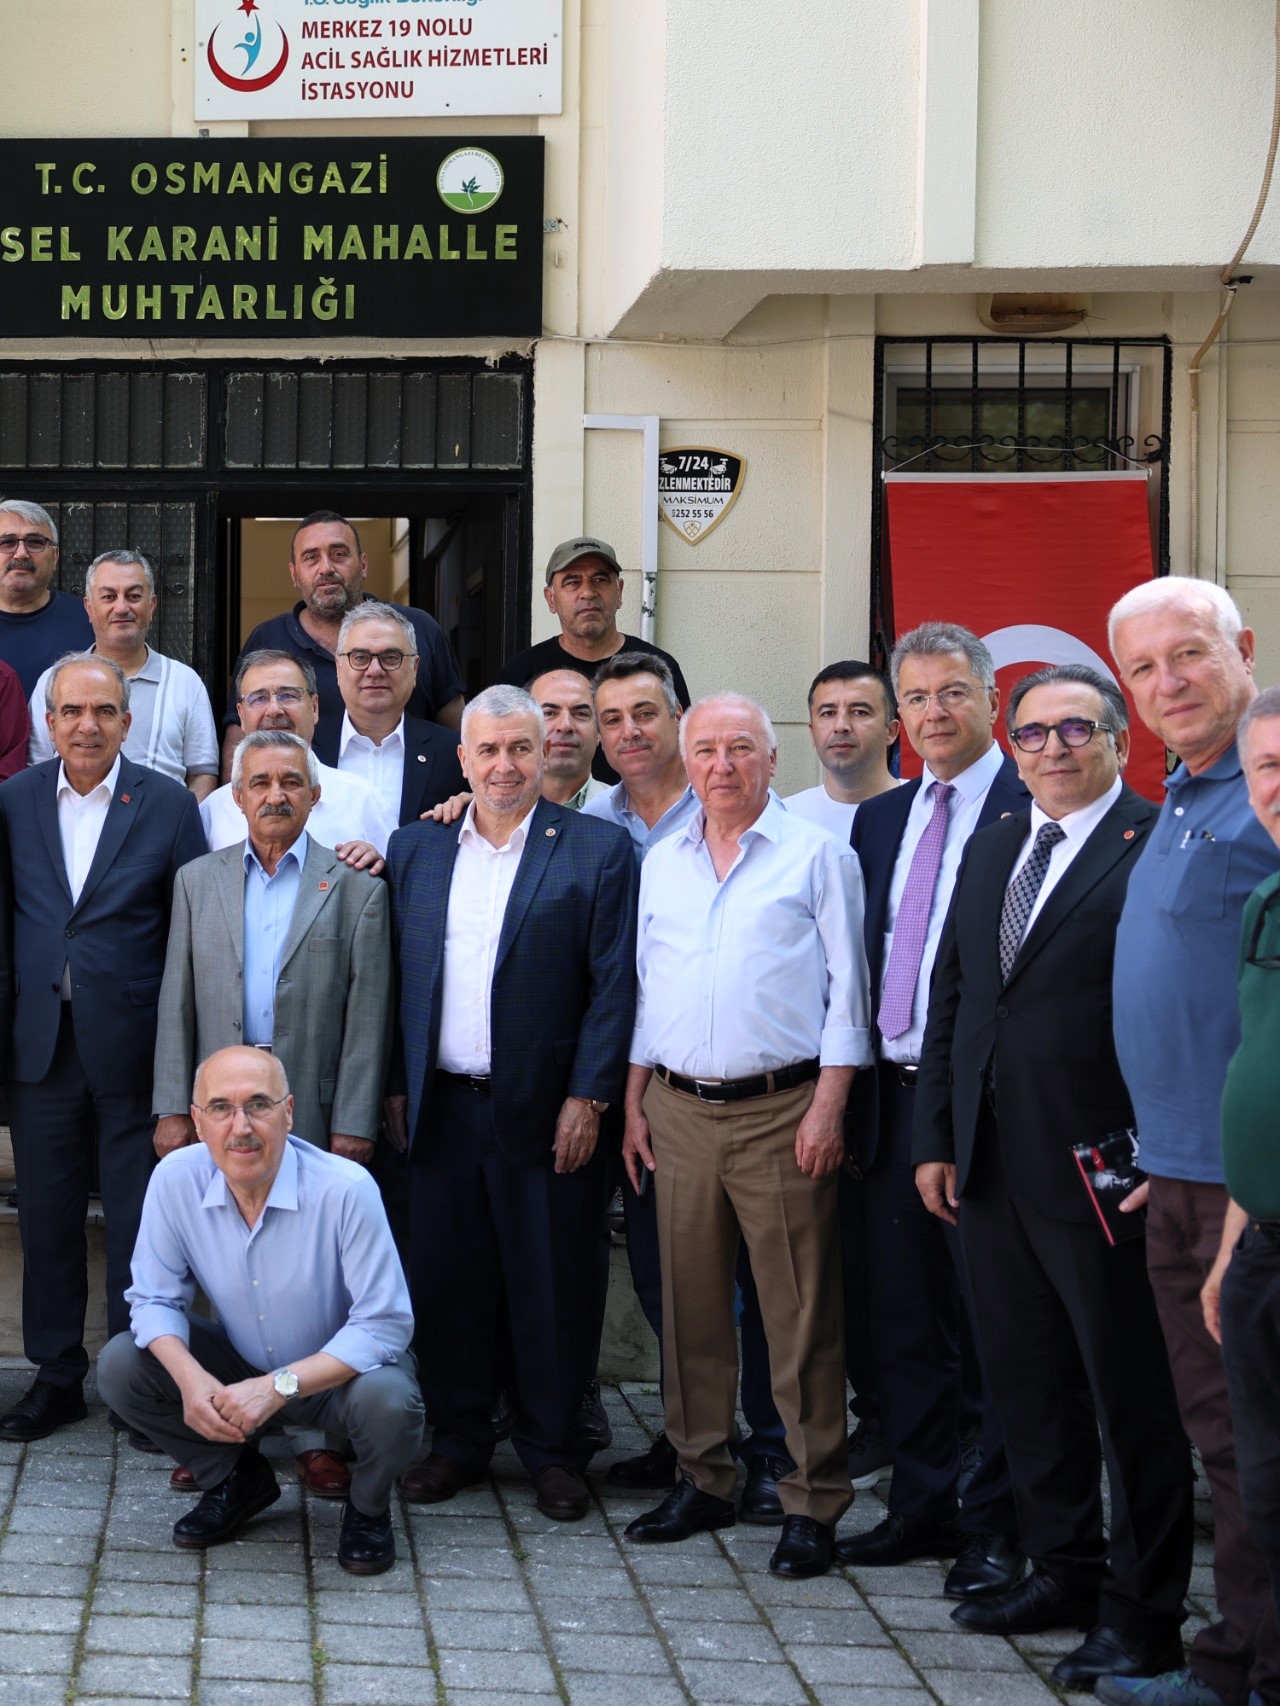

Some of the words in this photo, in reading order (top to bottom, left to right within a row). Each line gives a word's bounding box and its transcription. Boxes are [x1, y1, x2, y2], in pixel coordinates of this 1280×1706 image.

[302, 20, 382, 39] MERKEZ
[389, 20, 410, 37] 19
[418, 18, 472, 36] NOLU
[301, 47, 345, 69] ACİL
[351, 46, 422, 68] SAĞLIK
[428, 43, 548, 67] HİZMETLERİ
[301, 79, 414, 101] İSTASYONU
[35, 162, 106, 194] T.C.
[131, 154, 388, 195] OSMANGAZİ
[107, 216, 278, 262] KARANİ
[303, 224, 518, 261] MAHALLE
[61, 276, 355, 321] MUHTARLIĞI
[678, 456, 709, 472] 7/24
[658, 474, 731, 491] ZLENMEKTEDİR
[663, 495, 724, 505] MAKSİMUM
[675, 509, 690, 518] 252
[692, 509, 702, 518] 55
[704, 509, 714, 518] 56
